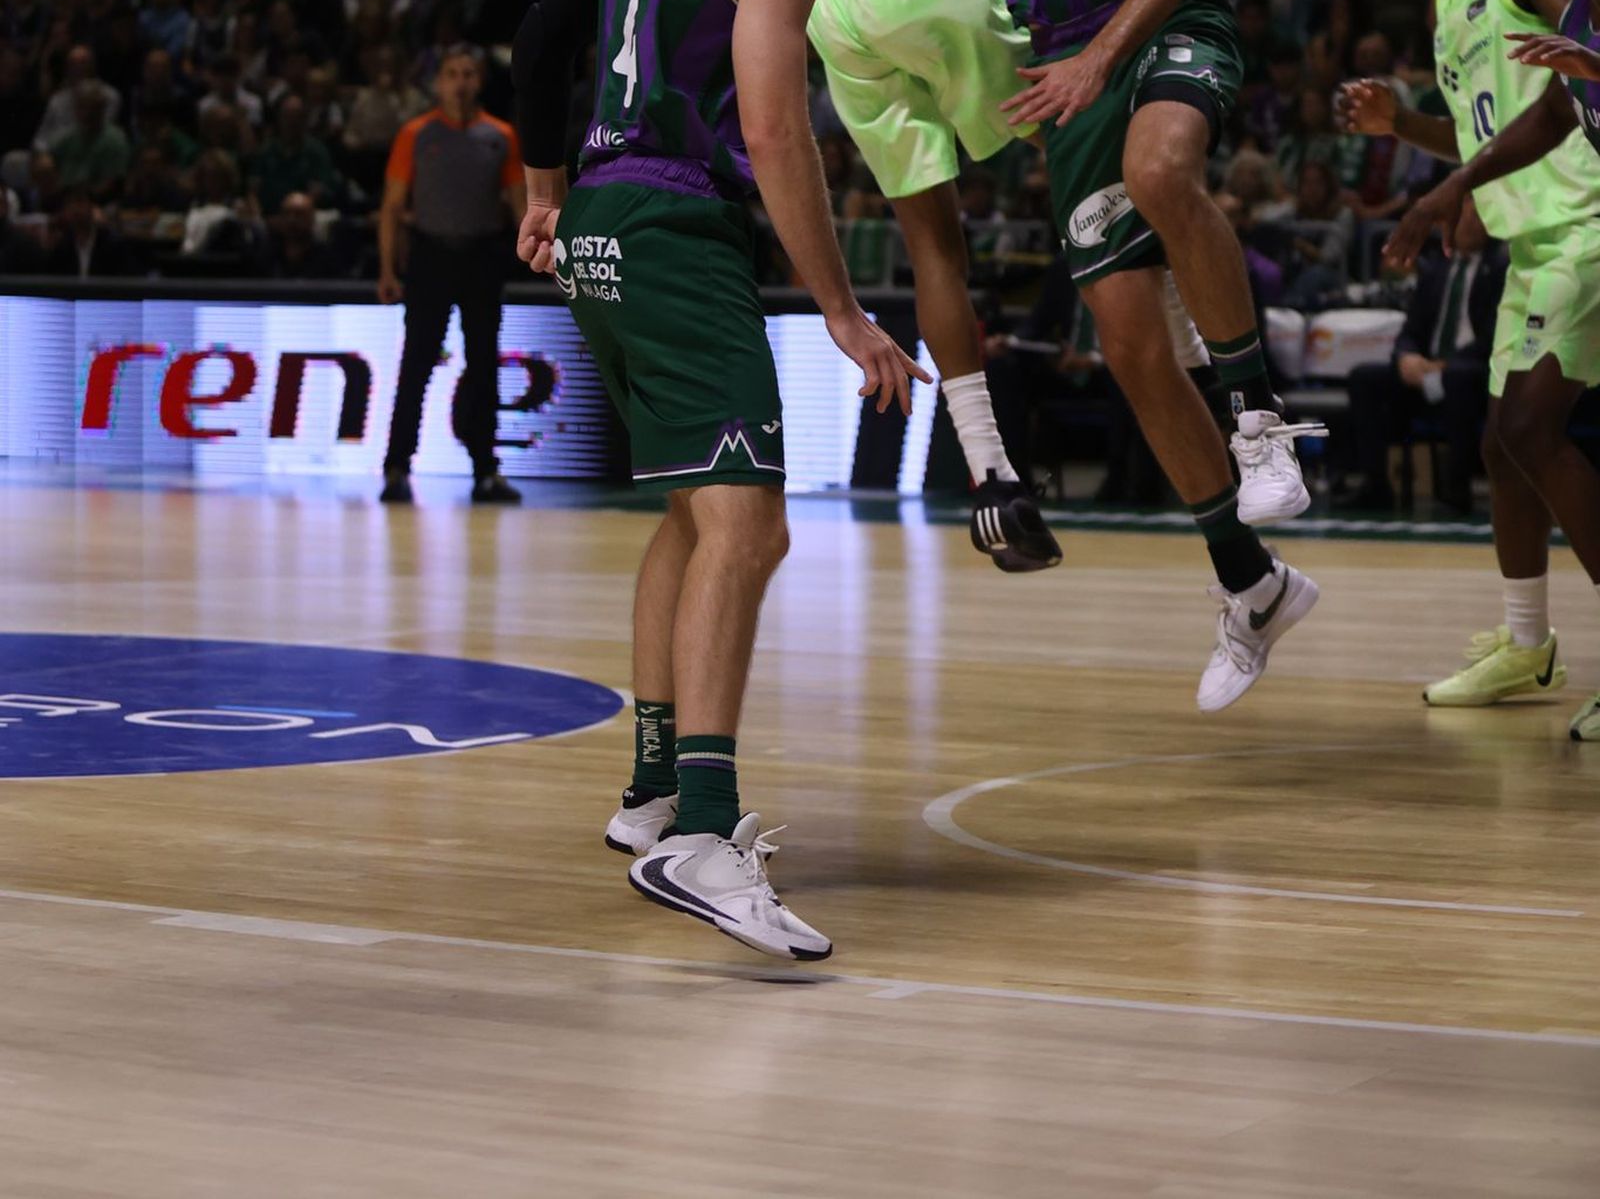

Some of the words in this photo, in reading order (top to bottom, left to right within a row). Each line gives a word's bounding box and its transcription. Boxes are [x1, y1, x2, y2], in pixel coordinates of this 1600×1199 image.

[571, 235, 622, 260] COSTA
[573, 261, 588, 279] DEL
[588, 262, 622, 282] SOL
[78, 342, 562, 448] rene
